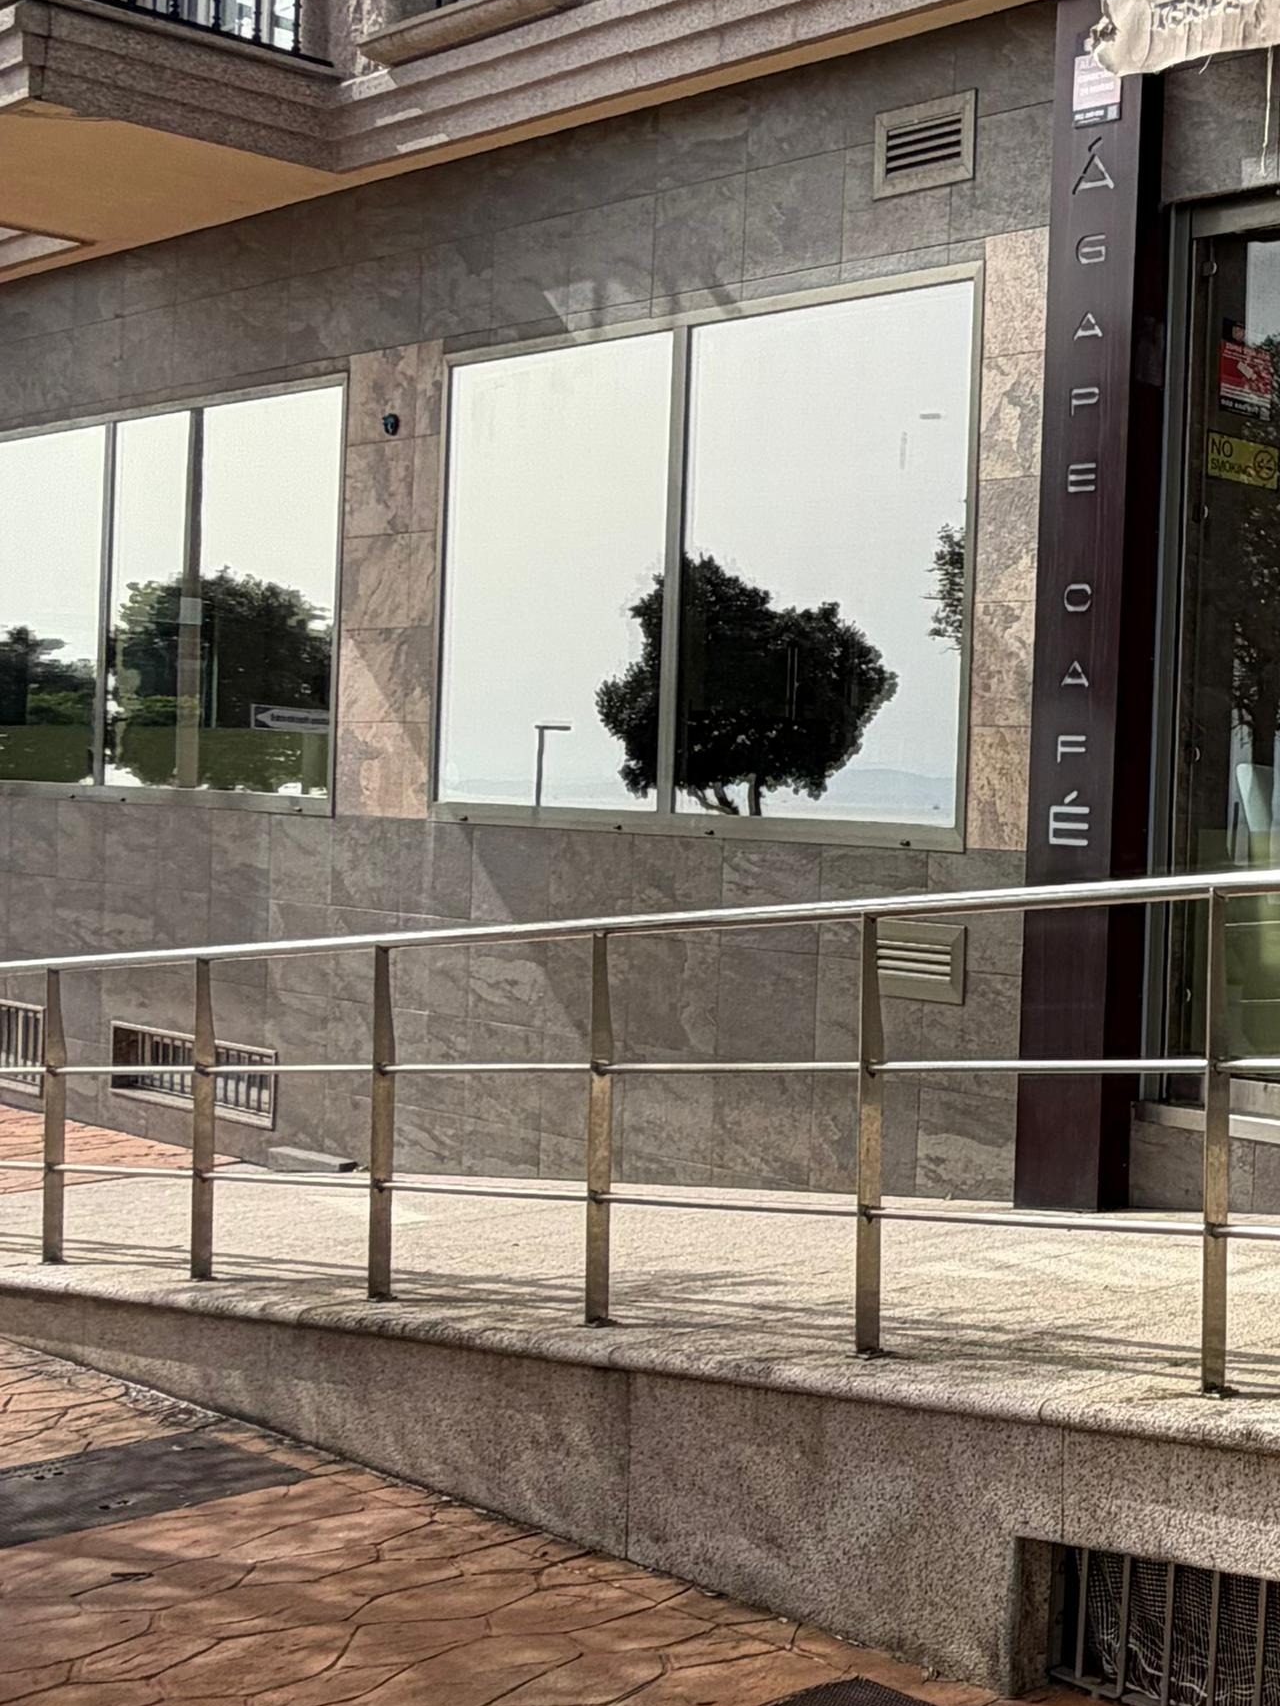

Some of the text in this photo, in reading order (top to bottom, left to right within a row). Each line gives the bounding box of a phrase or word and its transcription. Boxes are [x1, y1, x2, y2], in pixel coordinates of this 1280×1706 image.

[1066, 136, 1115, 493] ÁGAPE
[1211, 437, 1234, 458] NO
[1049, 582, 1093, 847] CAFÉ
